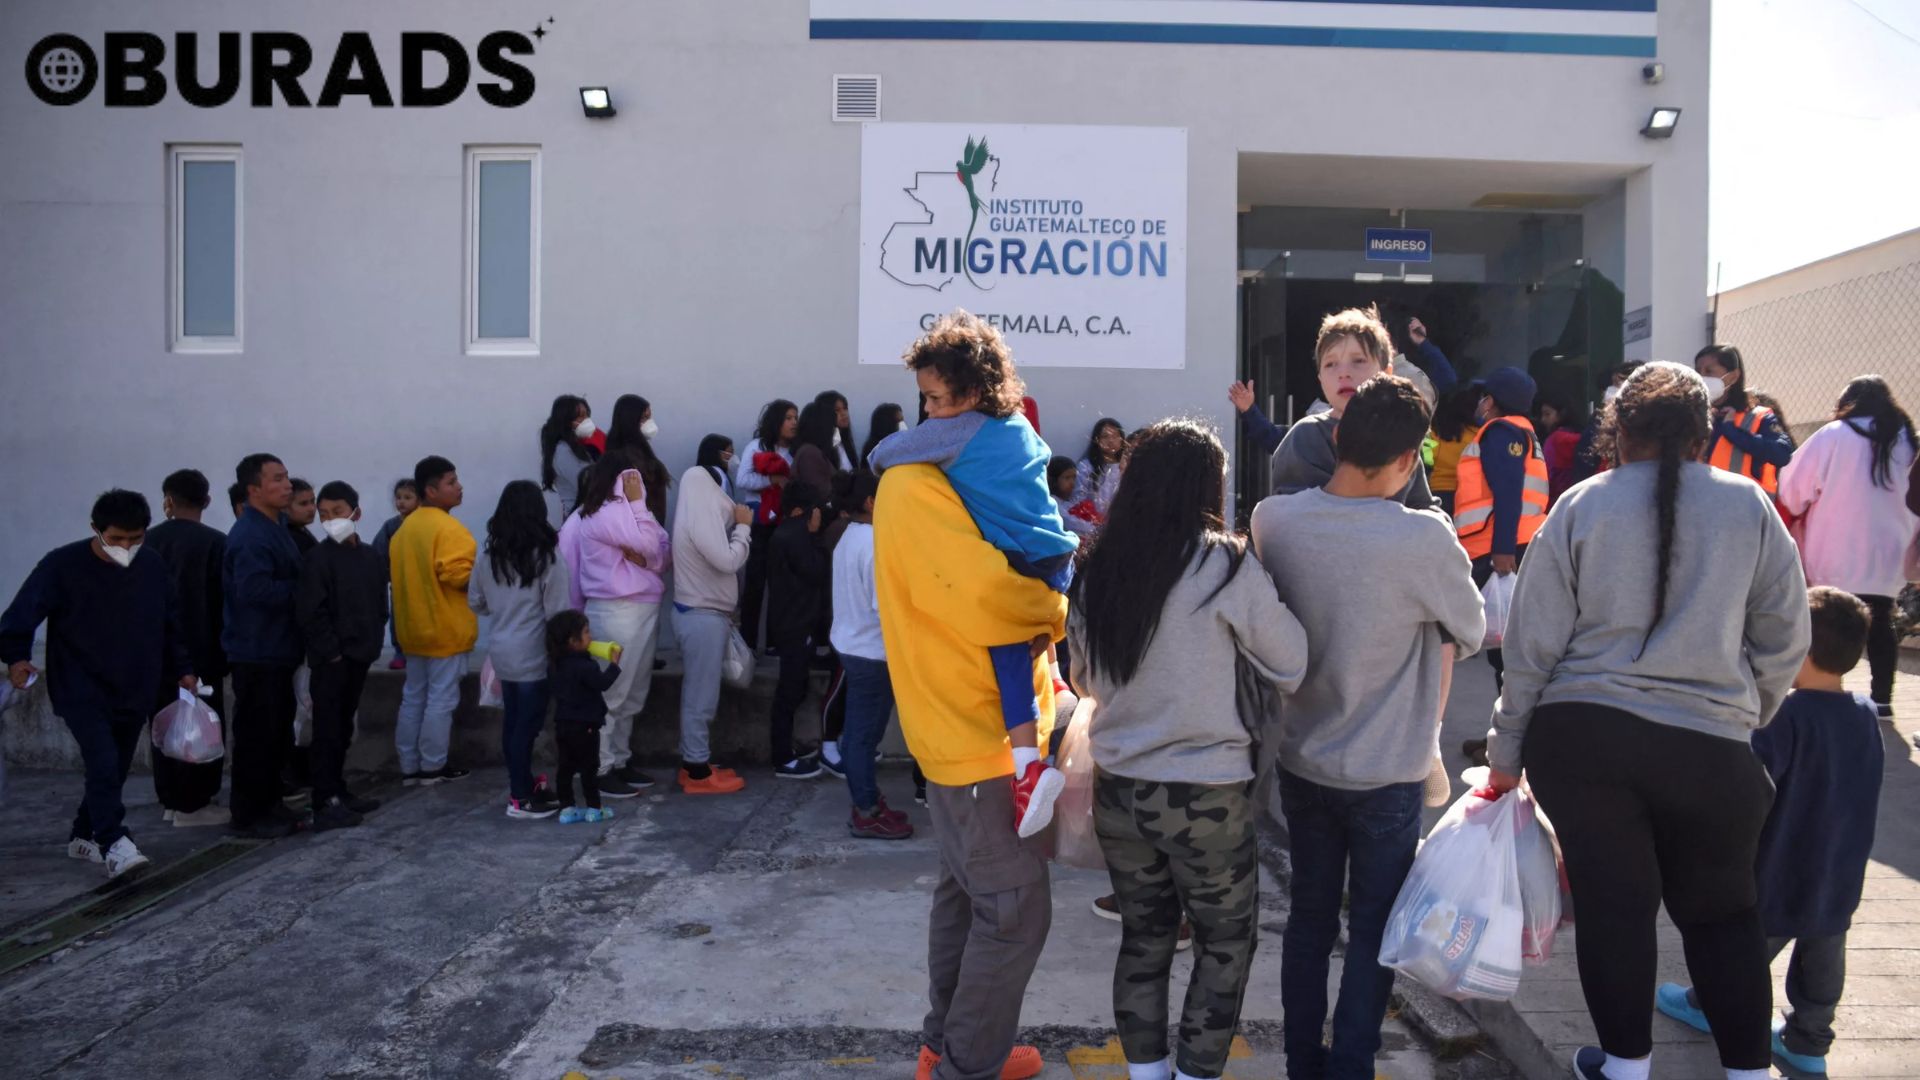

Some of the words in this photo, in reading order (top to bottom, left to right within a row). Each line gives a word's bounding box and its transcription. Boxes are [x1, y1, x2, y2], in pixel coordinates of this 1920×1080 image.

[990, 198, 1083, 215] INSTITUTO
[990, 217, 1135, 235] GUATEMALTECO
[1143, 219, 1167, 235] DE
[1371, 239, 1427, 251] INGRESO
[915, 234, 1168, 277] MIGRACIÓN
[919, 313, 1079, 336] GEMALA,
[1085, 315, 1131, 335] C.A.
